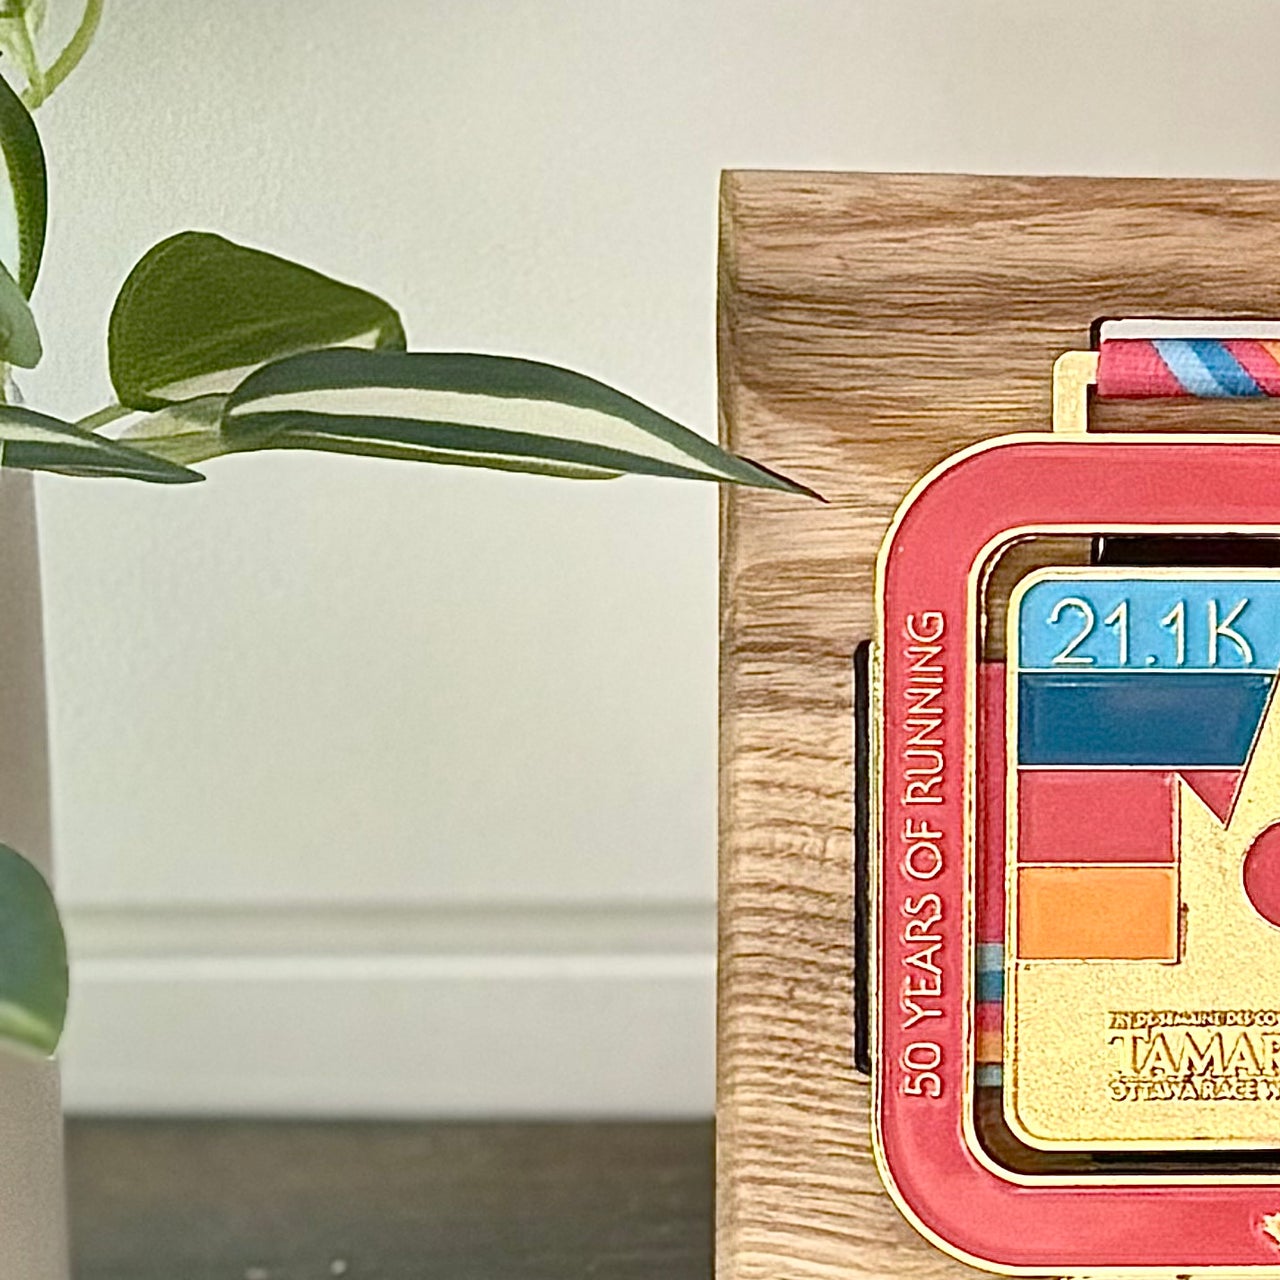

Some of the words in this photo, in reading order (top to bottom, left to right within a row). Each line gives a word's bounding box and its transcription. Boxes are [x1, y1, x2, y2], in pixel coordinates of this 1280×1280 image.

[1047, 596, 1254, 667] 21.1K
[904, 610, 946, 806] RUNNING
[904, 818, 944, 881] OF
[904, 893, 943, 1030] YEARS
[904, 1041, 943, 1100] 50
[1200, 1078, 1258, 1101] RACE
